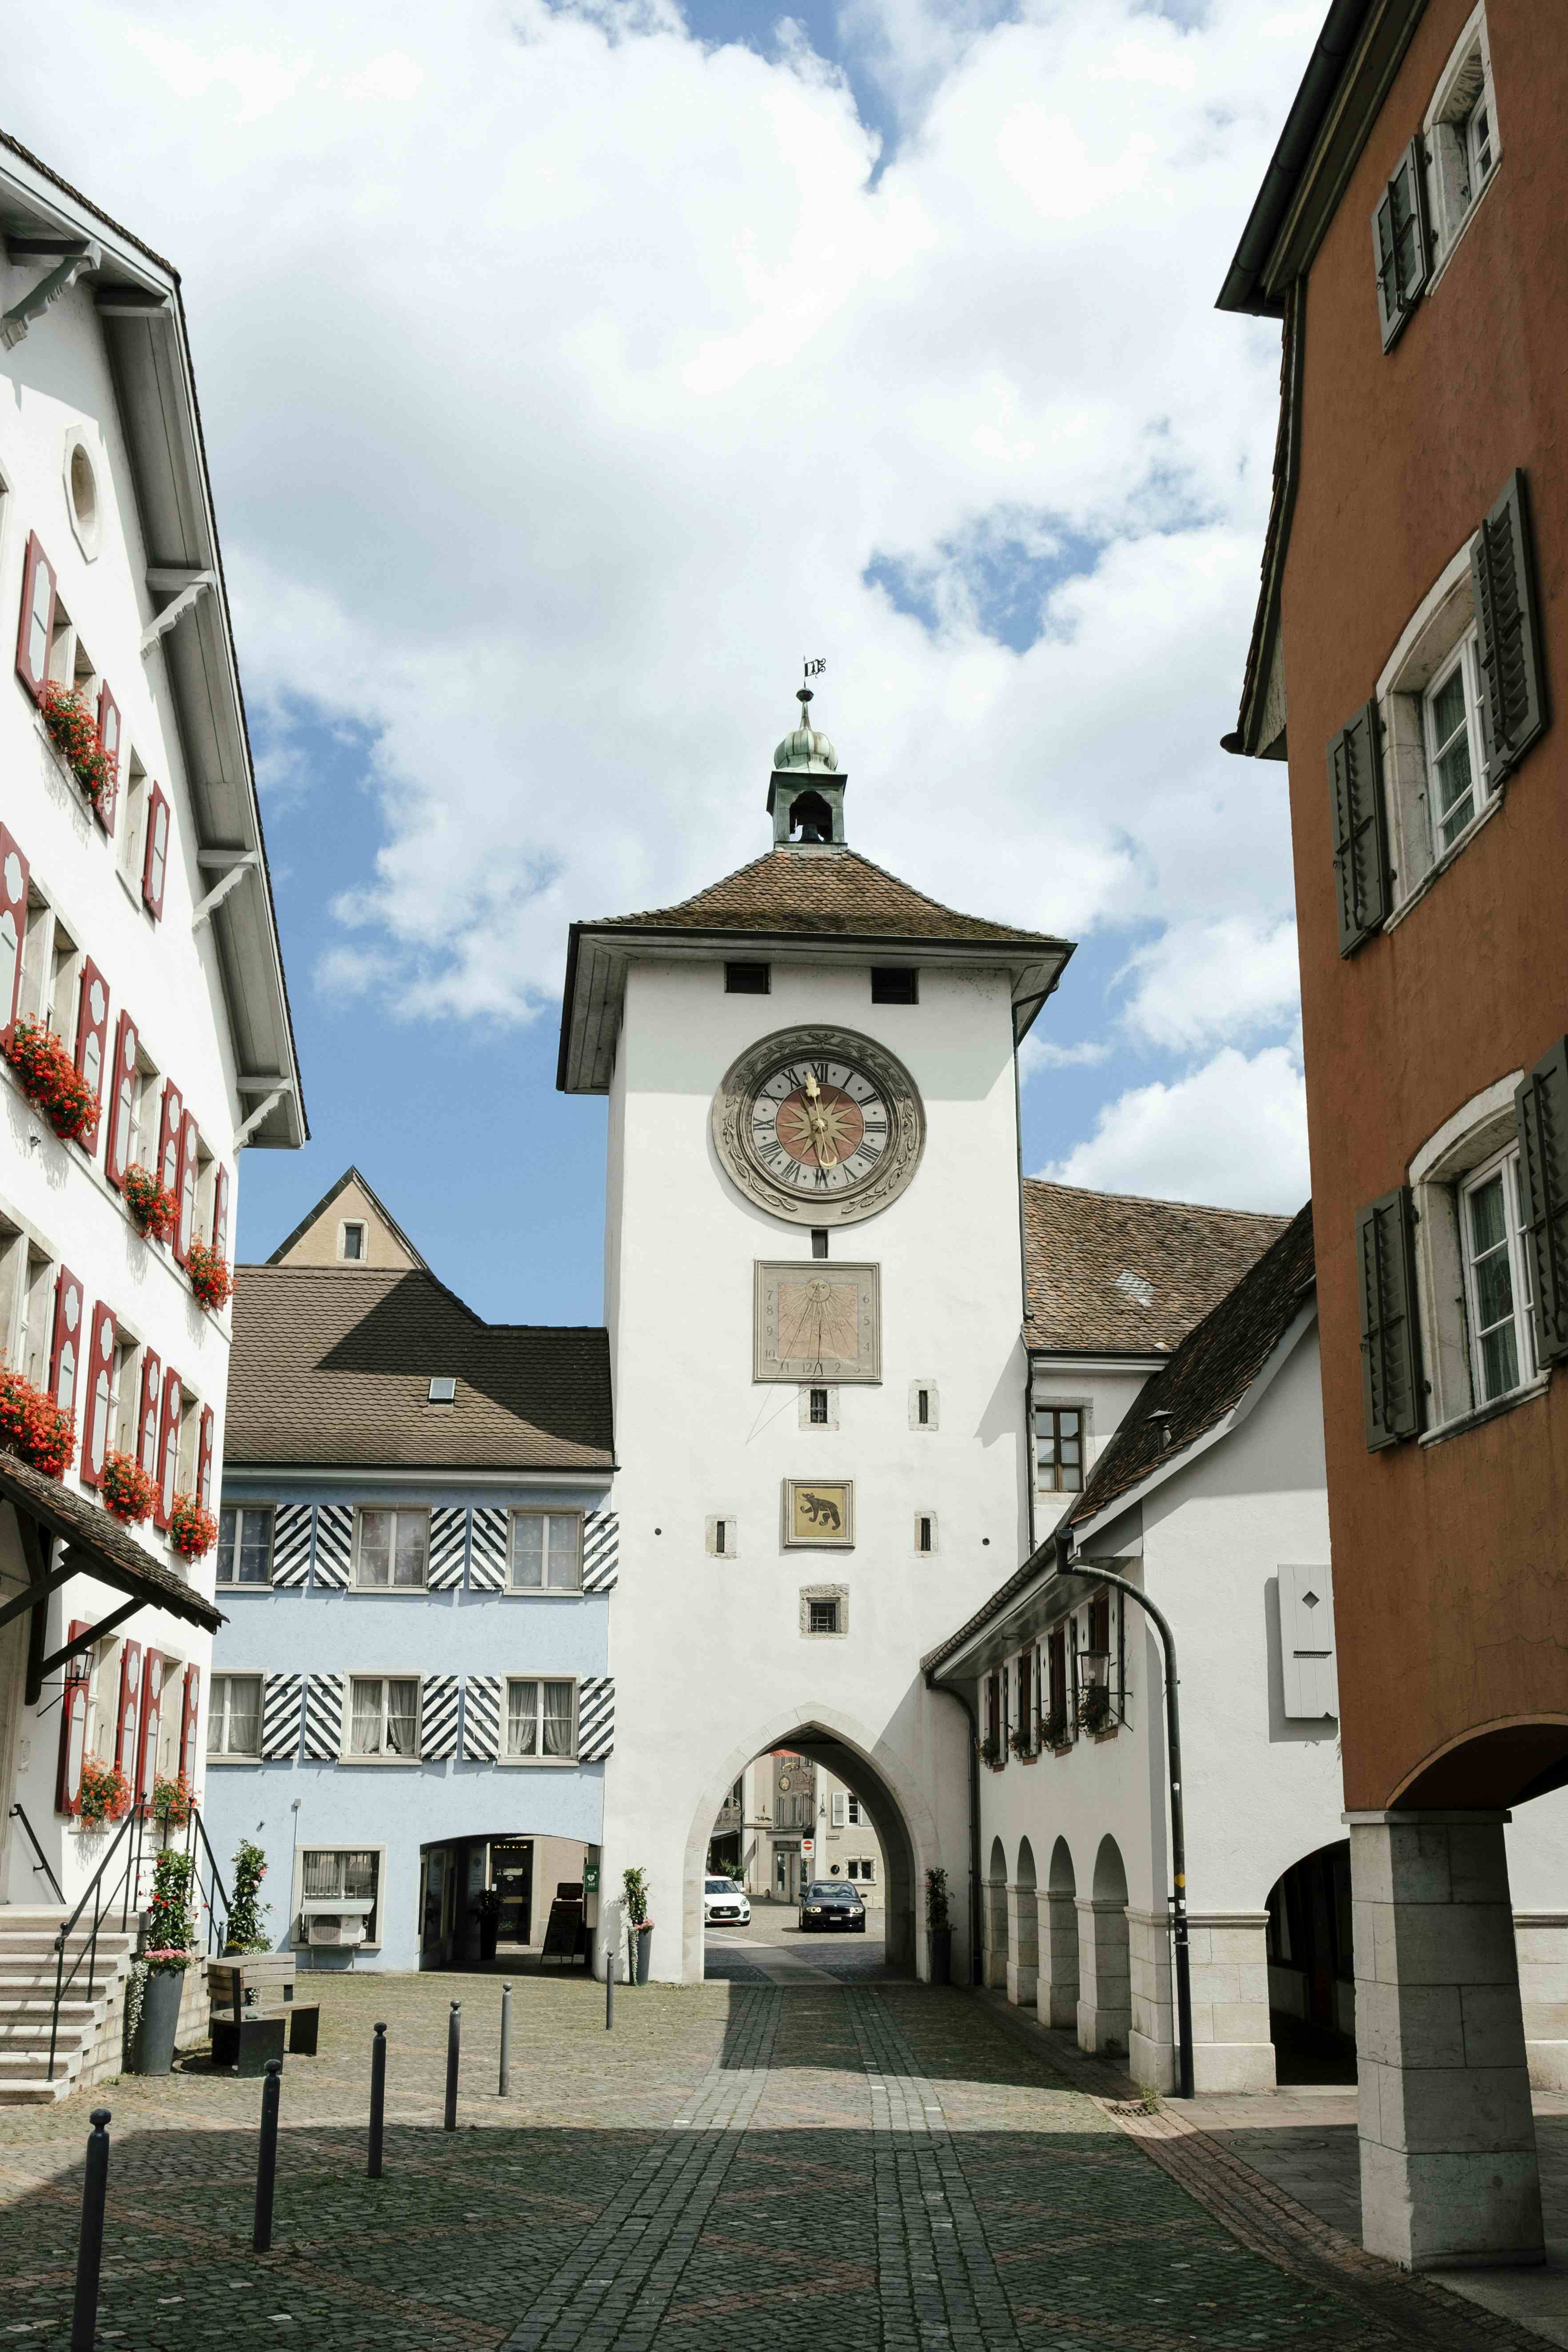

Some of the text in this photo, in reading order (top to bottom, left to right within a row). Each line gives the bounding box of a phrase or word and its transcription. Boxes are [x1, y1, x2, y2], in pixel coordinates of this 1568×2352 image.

[781, 1067, 804, 1091] XI
[810, 1063, 829, 1083] XII
[839, 1070, 855, 1090] I
[759, 1089, 784, 1108] X
[856, 1091, 880, 1109] II
[753, 1116, 774, 1132] IX
[865, 1120, 886, 1134] III
[758, 1139, 783, 1166] VIII
[854, 1140, 882, 1166] IIII
[778, 1159, 801, 1183] VII
[813, 1168, 830, 1188] VI
[842, 1163, 860, 1184] V
[767, 1290, 773, 1301] 7
[863, 1294, 870, 1304] 6
[766, 1305, 774, 1315] 8
[863, 1316, 870, 1326] 5
[766, 1326, 773, 1336] 9
[765, 1349, 775, 1358] 10
[863, 1342, 871, 1351] 4
[781, 1362, 789, 1373] 11
[802, 1362, 812, 1372] 12
[835, 1362, 841, 1372] 2
